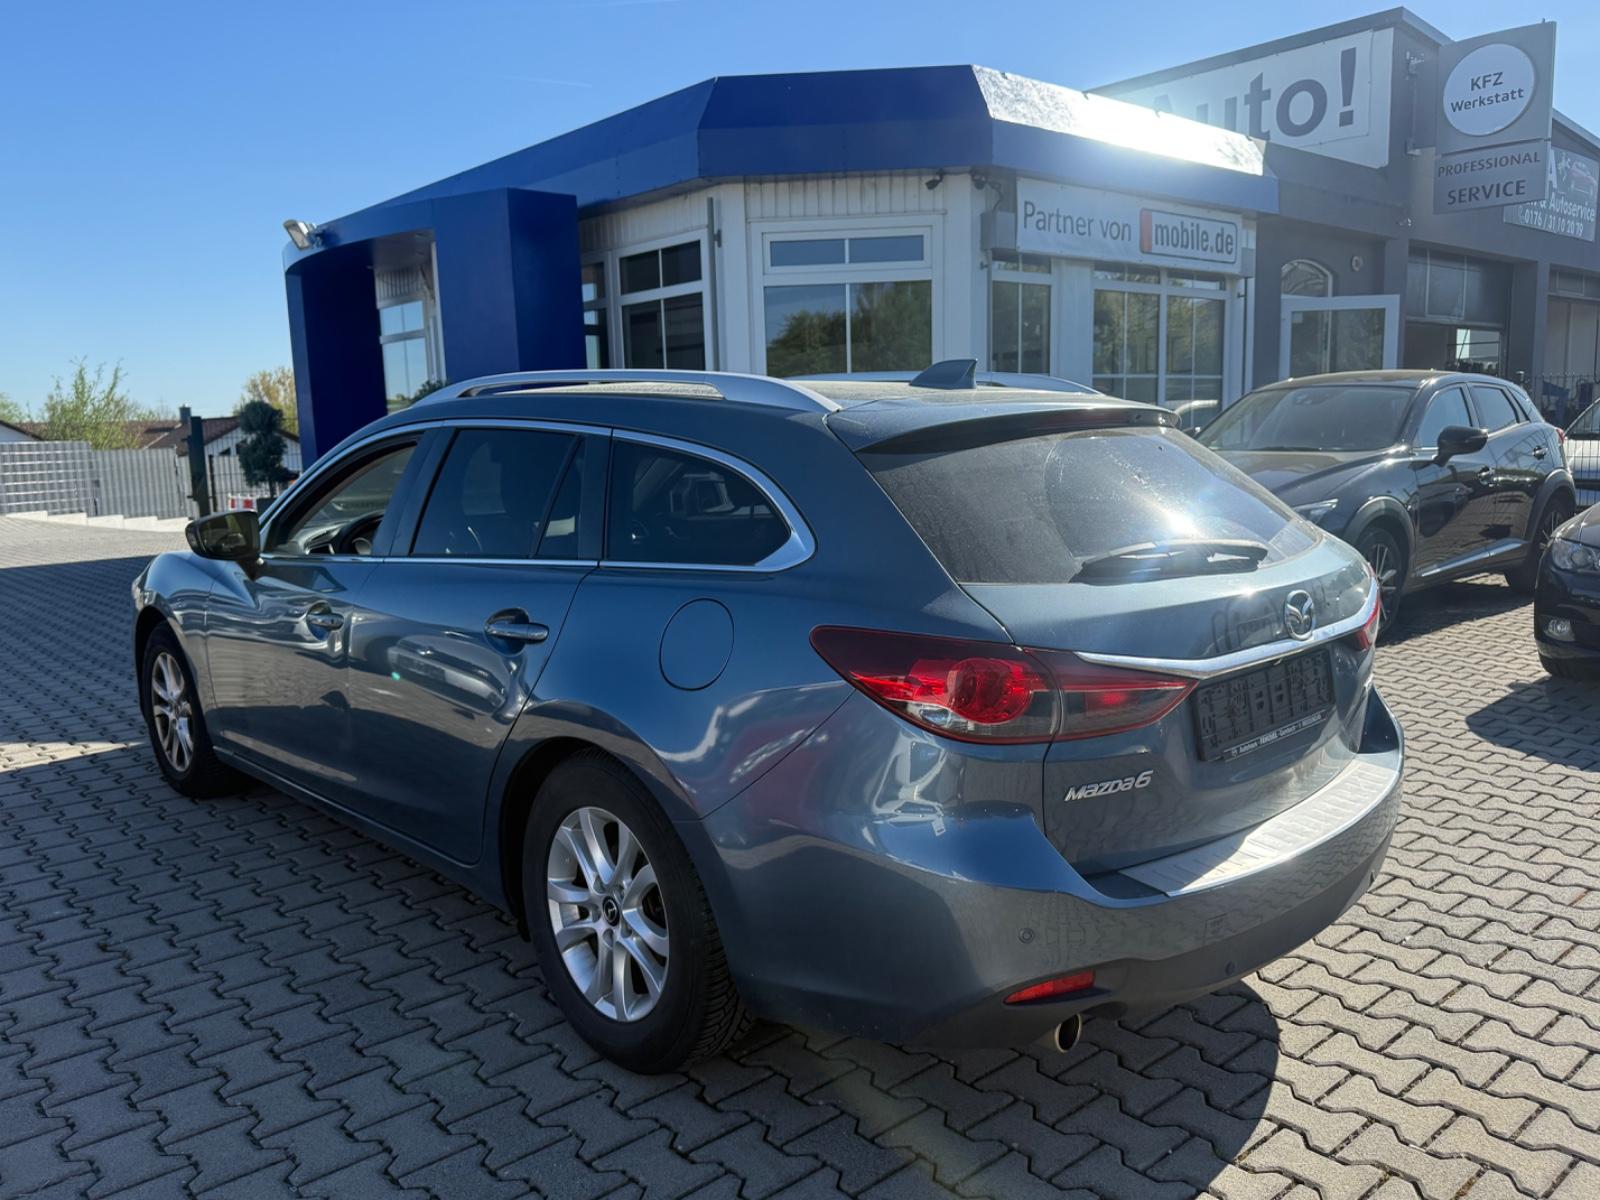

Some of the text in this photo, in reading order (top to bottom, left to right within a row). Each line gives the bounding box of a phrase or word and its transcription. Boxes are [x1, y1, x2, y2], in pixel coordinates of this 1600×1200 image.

[1154, 47, 1357, 140] to!
[1471, 72, 1504, 91] KFZ
[1451, 88, 1524, 112] Werkstatt
[1438, 152, 1541, 178] PROFESSIONAL
[1448, 180, 1526, 205] SERVICE
[1549, 192, 1595, 223] Autoservice
[1024, 201, 1234, 255] Partner von mobile.de
